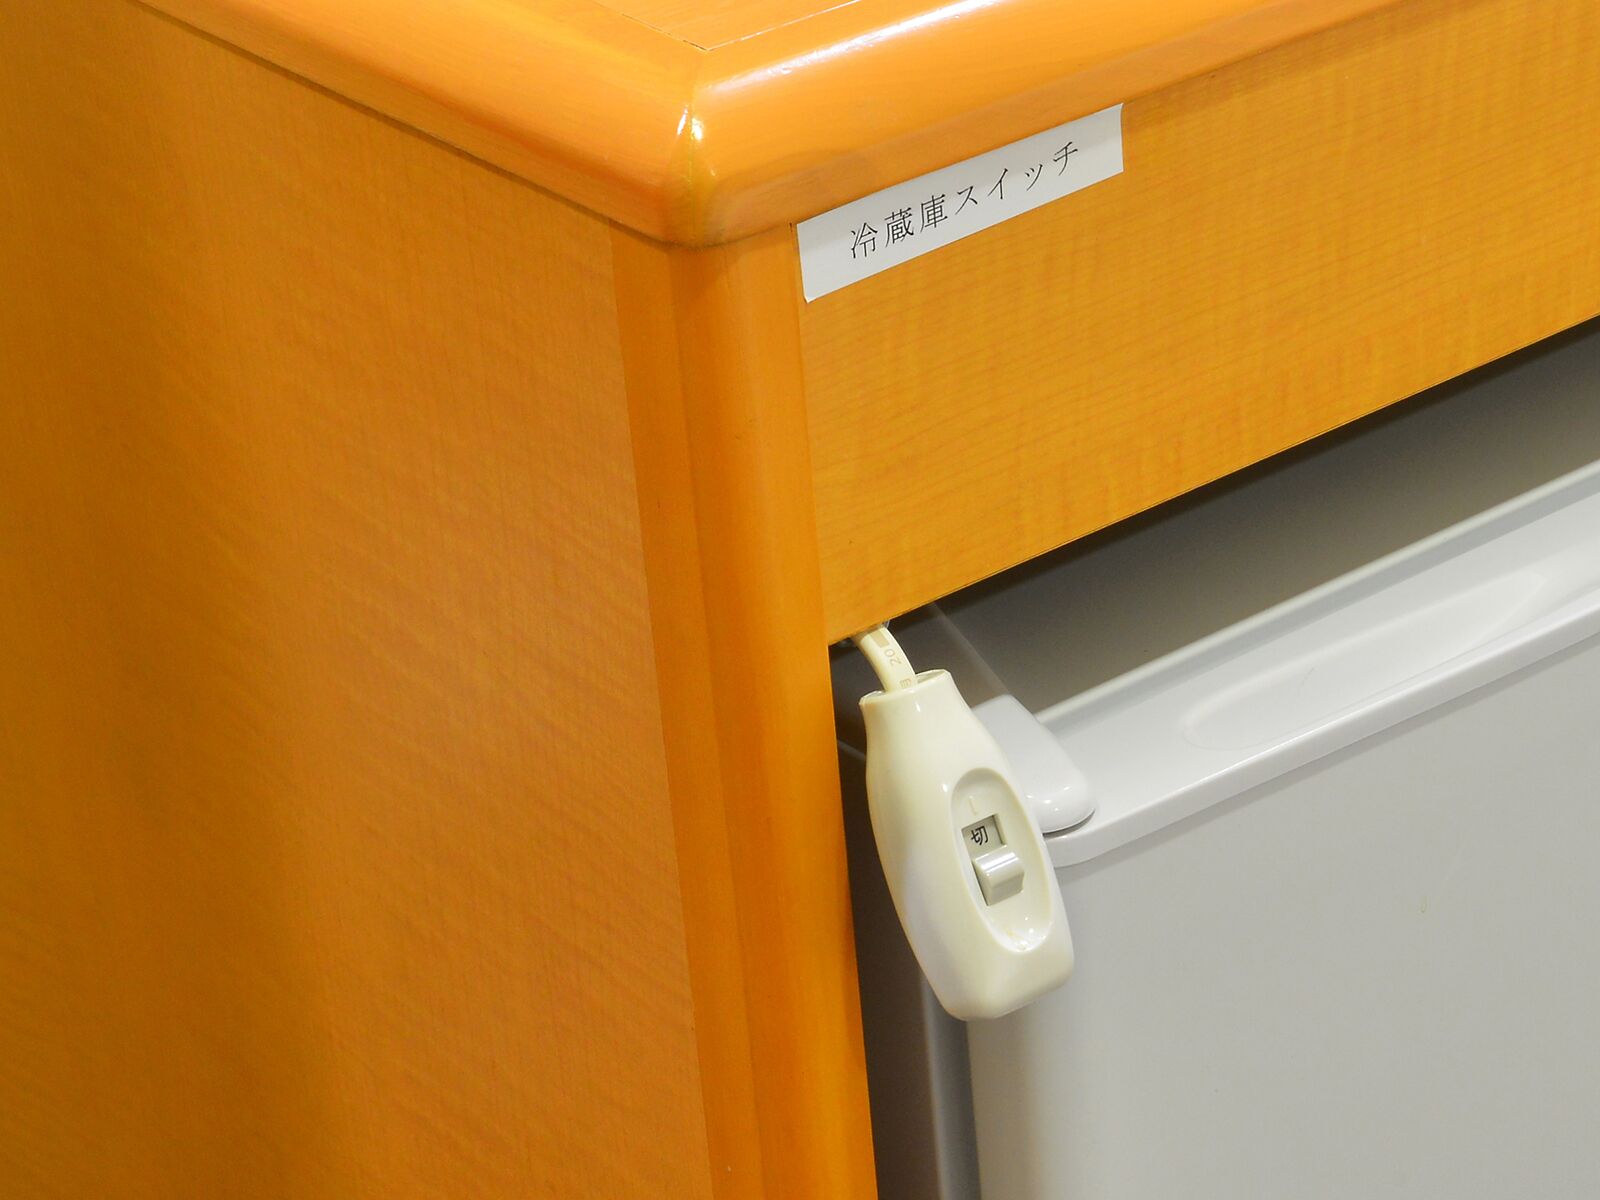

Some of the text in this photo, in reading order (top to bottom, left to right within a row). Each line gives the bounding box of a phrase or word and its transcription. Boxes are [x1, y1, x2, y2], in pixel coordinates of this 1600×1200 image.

[850, 141, 1078, 258] 冷蔵庫スイッチ
[970, 825, 989, 846] 切
